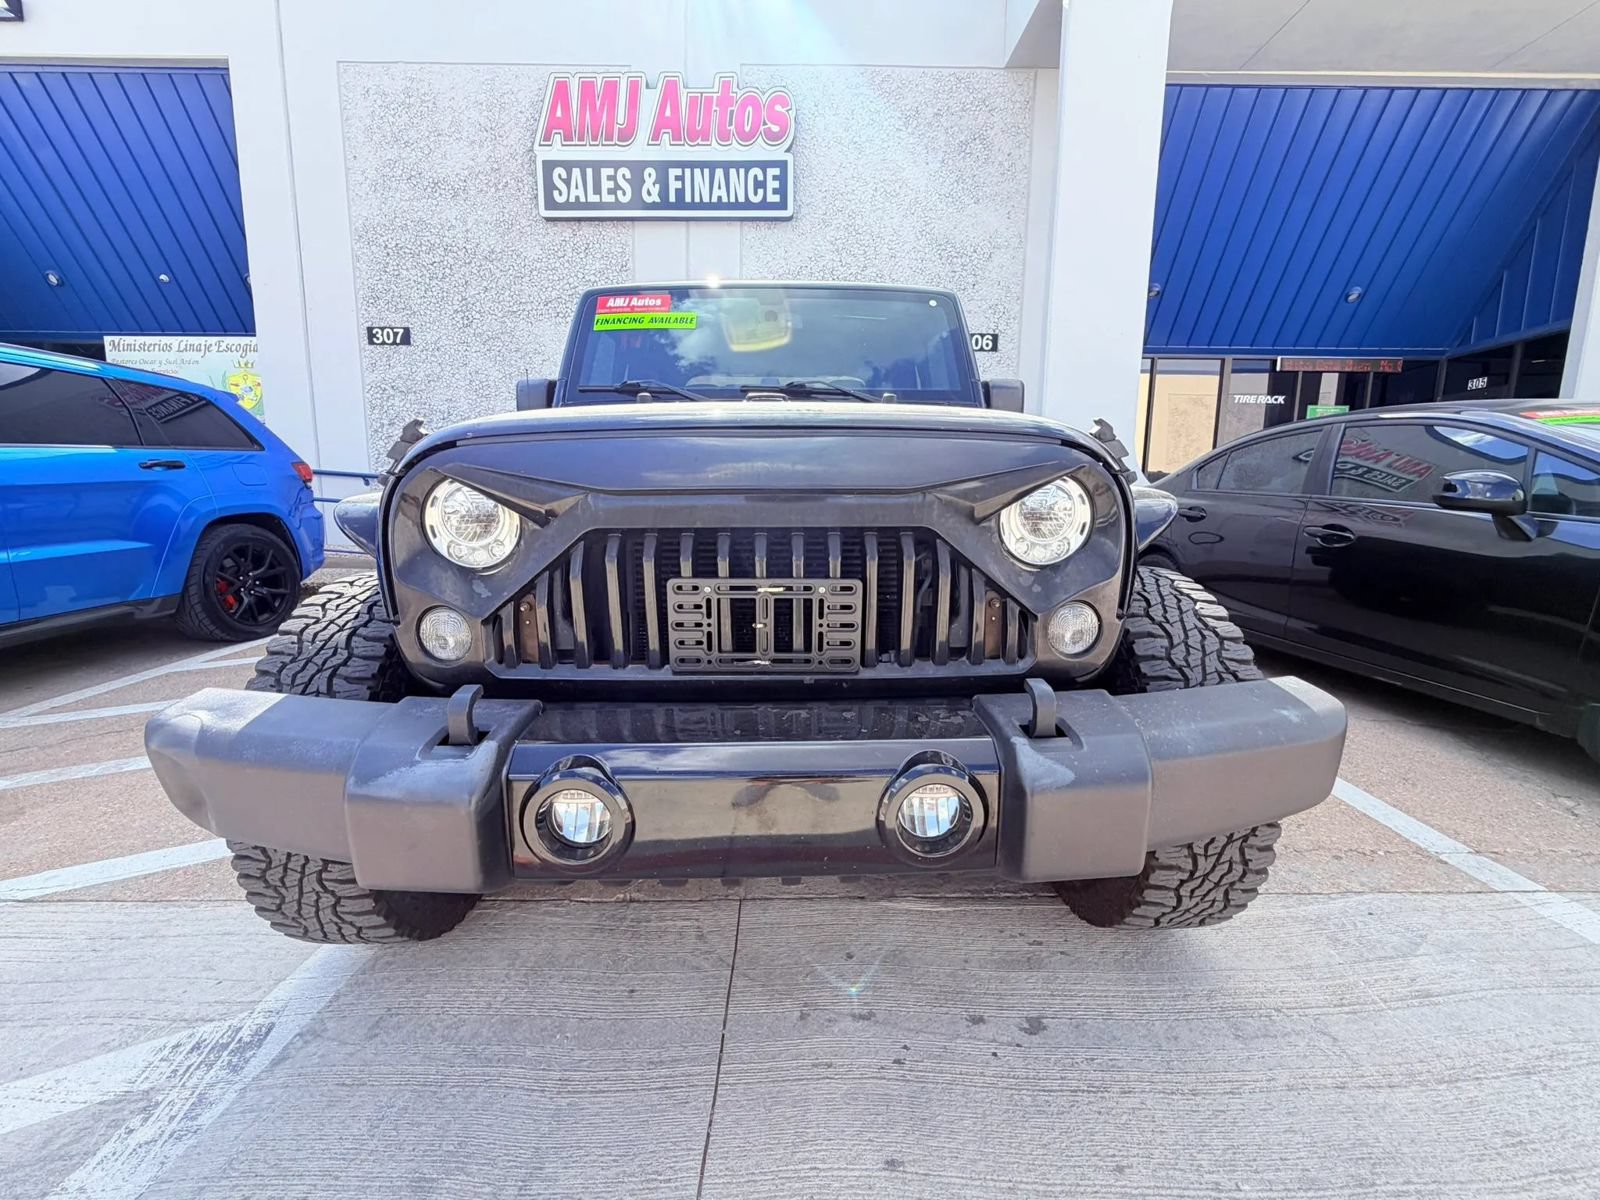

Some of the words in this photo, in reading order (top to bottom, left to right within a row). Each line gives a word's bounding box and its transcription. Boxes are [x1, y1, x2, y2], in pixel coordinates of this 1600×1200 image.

[541, 78, 643, 145] AMJ
[649, 77, 792, 145] Autos
[552, 166, 632, 204] SALES
[641, 167, 661, 204] &
[668, 167, 781, 204] FINANCE
[606, 297, 629, 307] AMJ
[630, 296, 662, 306] Autos
[595, 316, 645, 326] FINANCING
[647, 316, 696, 325] AVAILABLE
[372, 327, 404, 344] 307
[971, 334, 993, 350] 06
[109, 337, 173, 353] Ministerios
[176, 339, 213, 358] Linaje
[1467, 376, 1488, 391] 305
[1233, 394, 1258, 404] TIRE
[1256, 394, 1286, 405] RACK
